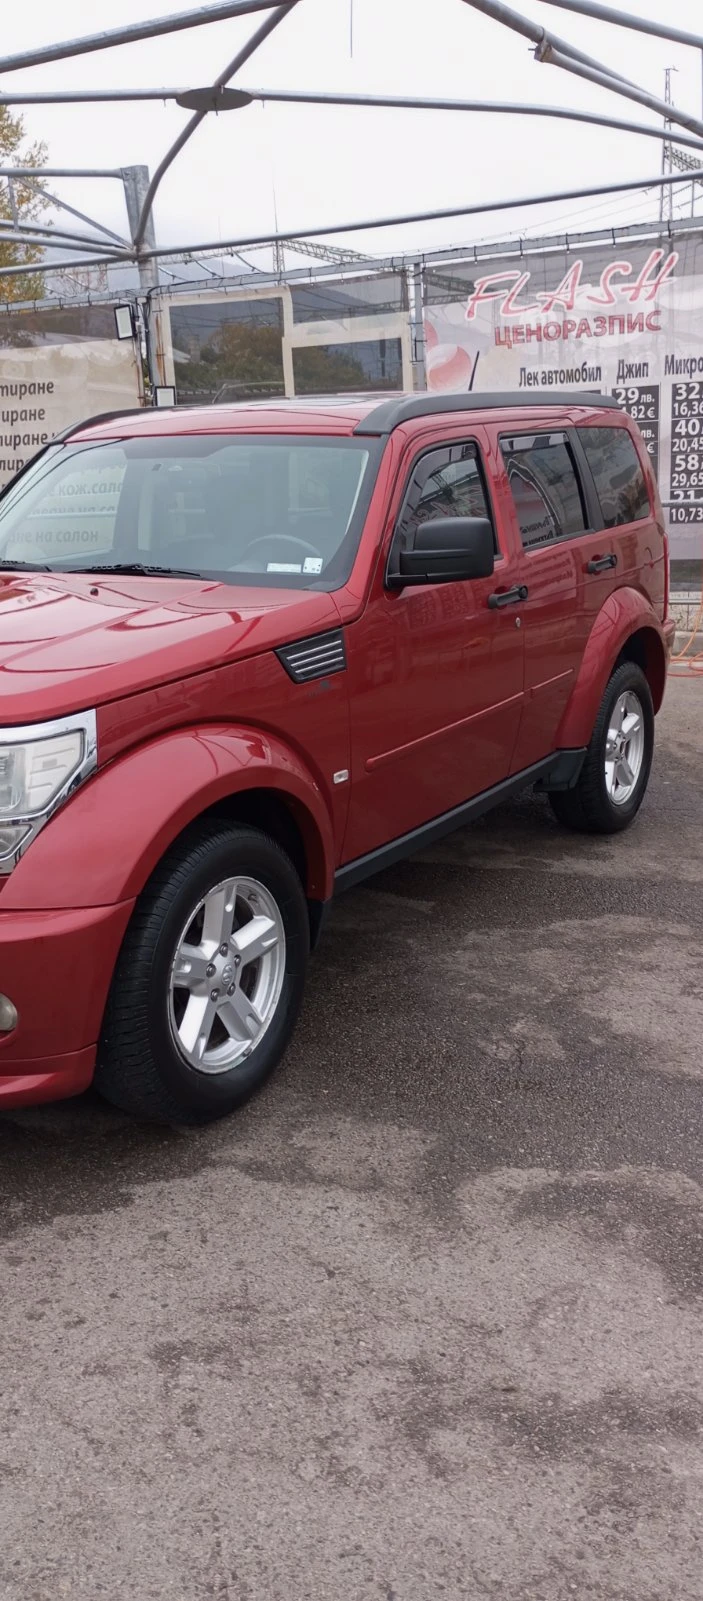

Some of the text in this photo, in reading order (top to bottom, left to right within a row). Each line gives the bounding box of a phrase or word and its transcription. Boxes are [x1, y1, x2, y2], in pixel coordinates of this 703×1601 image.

[465, 249, 679, 319] FLASH
[494, 310, 662, 348] ЦЕНОРАЗПИС
[519, 362, 602, 387] Лек автомобил
[616, 359, 649, 384] Джип
[664, 354, 703, 379] Микро
[615, 388, 655, 405] 29 лв.
[675, 383, 700, 400] 32
[674, 419, 700, 436] 40
[674, 454, 699, 471] 58
[56, 530, 99, 543] салон
